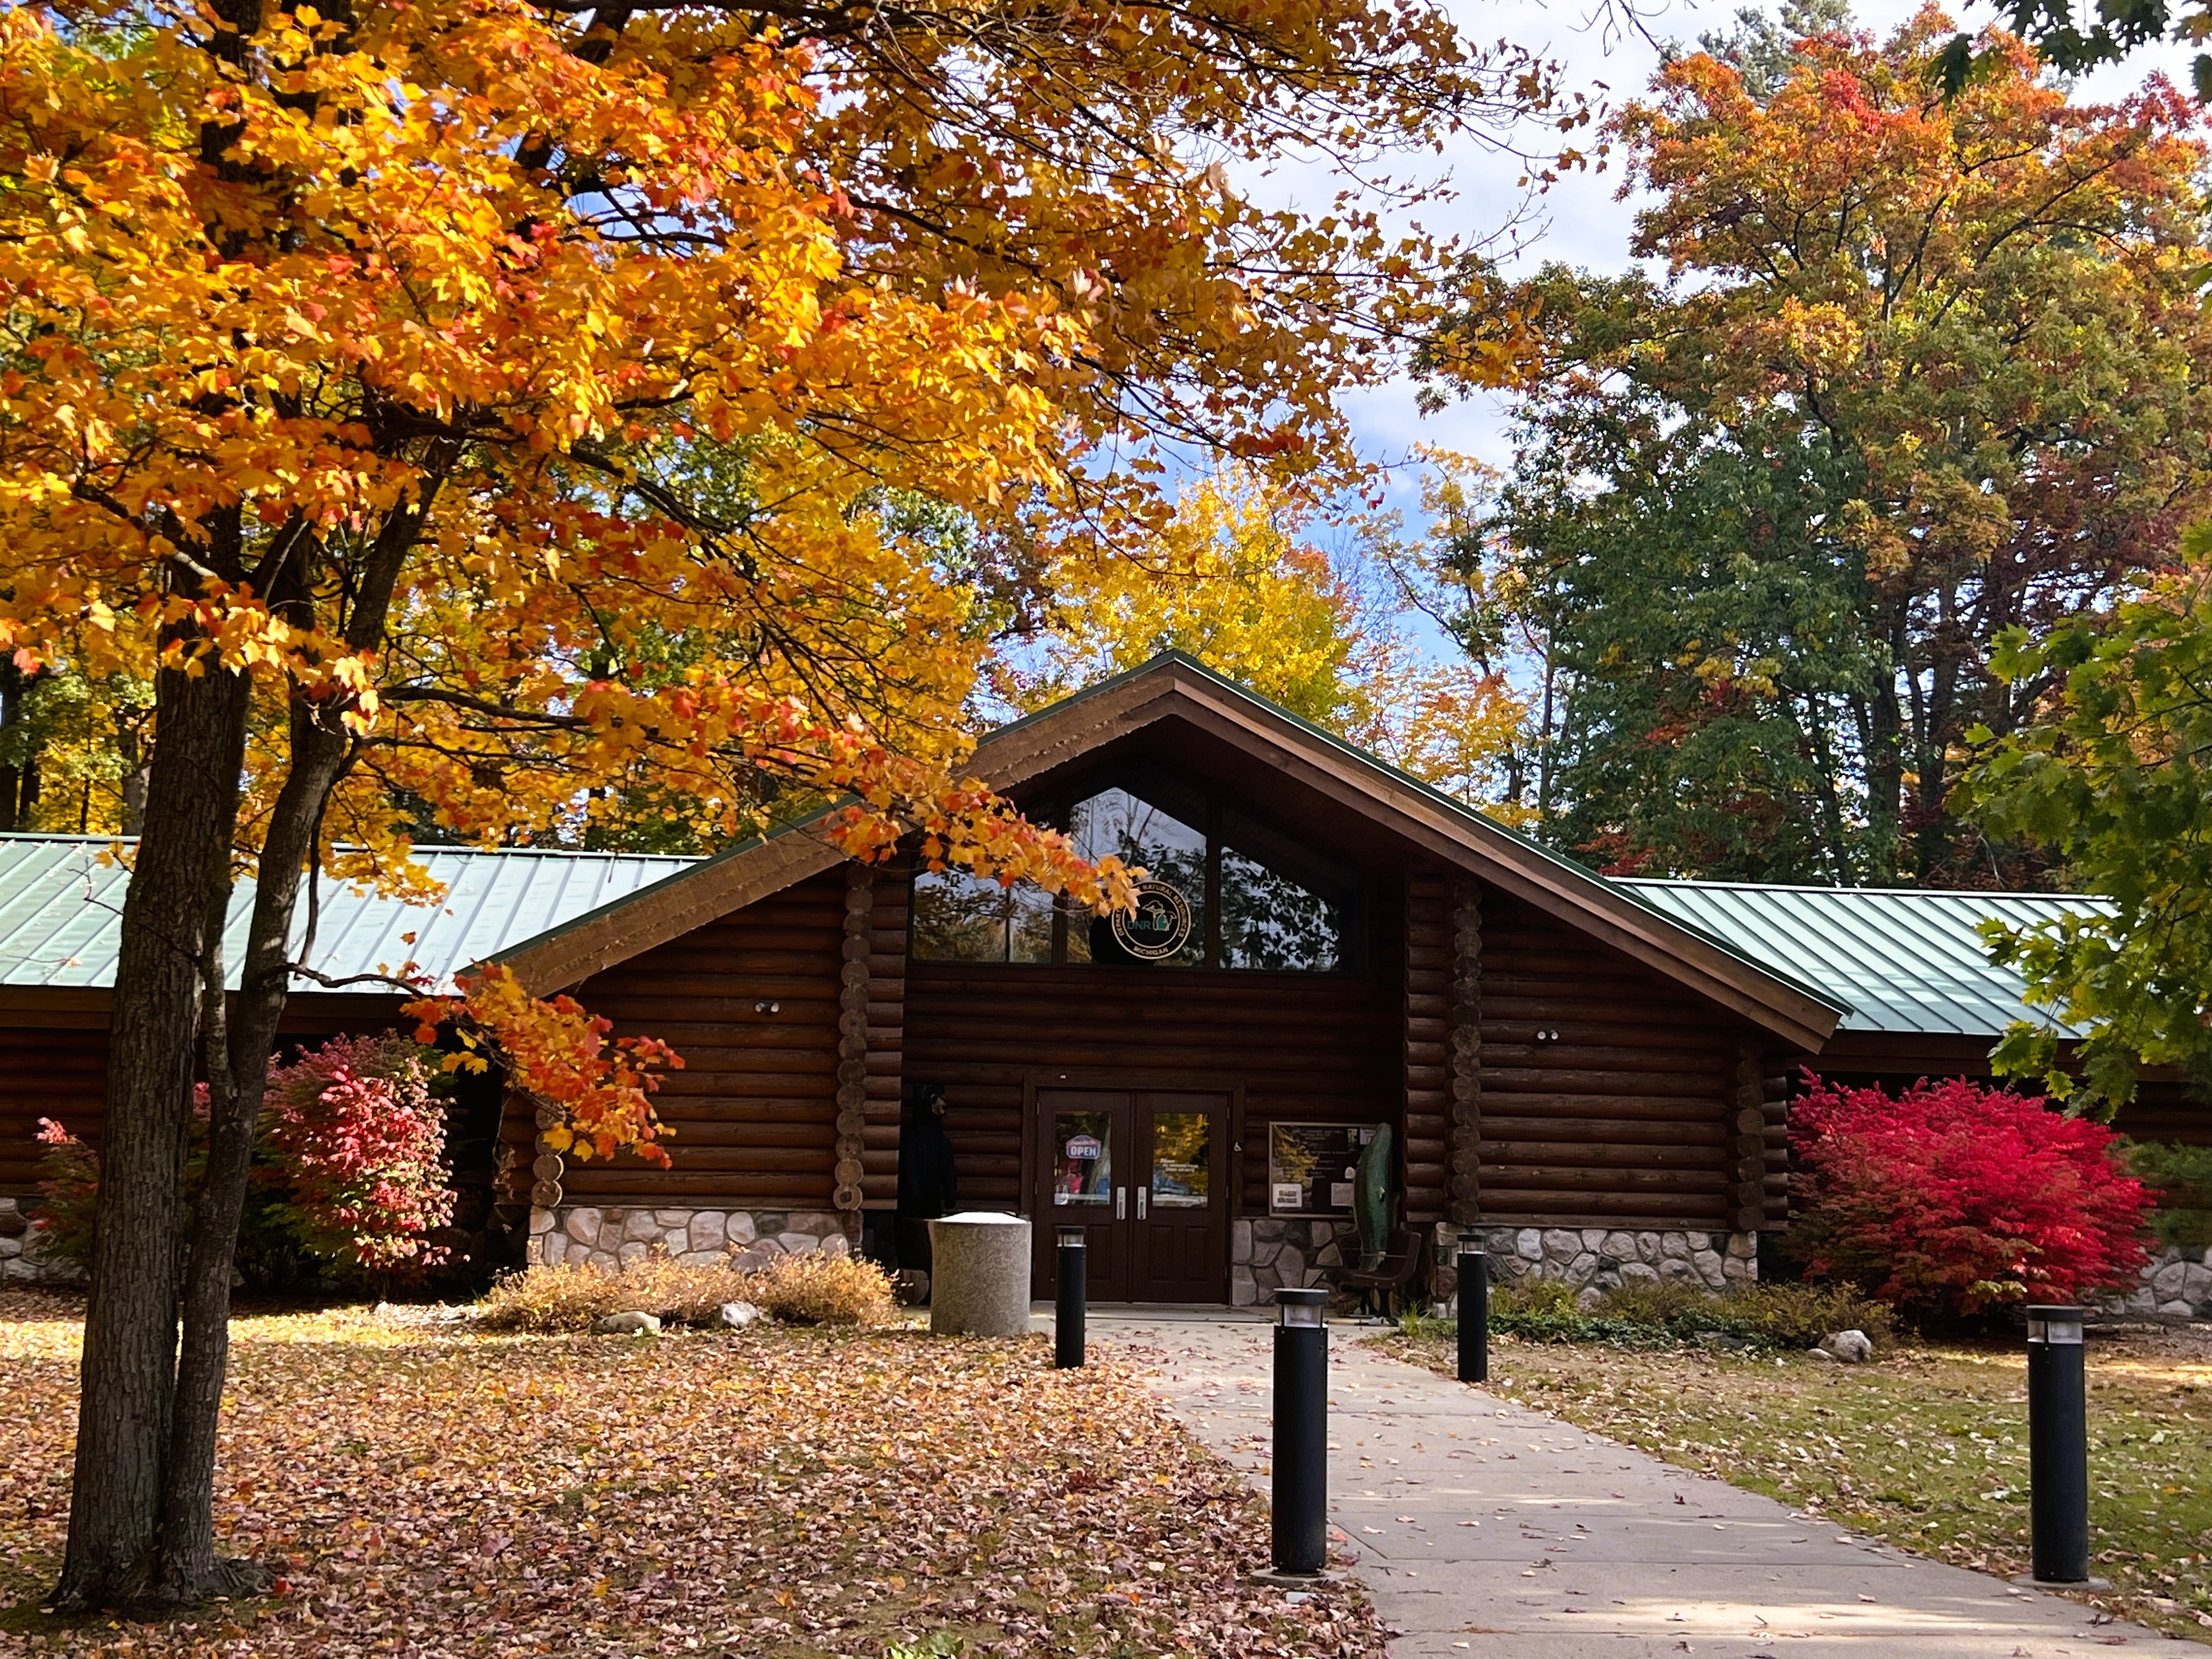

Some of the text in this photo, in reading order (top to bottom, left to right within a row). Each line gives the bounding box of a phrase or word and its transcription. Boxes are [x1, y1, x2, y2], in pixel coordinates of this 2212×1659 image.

[1142, 884, 1172, 897] NATURAL
[1173, 895, 1187, 938] RESOURCES
[1127, 920, 1152, 930] DNR
[1133, 945, 1169, 955] MICHIGAN
[1070, 1146, 1097, 1156] OPEN
